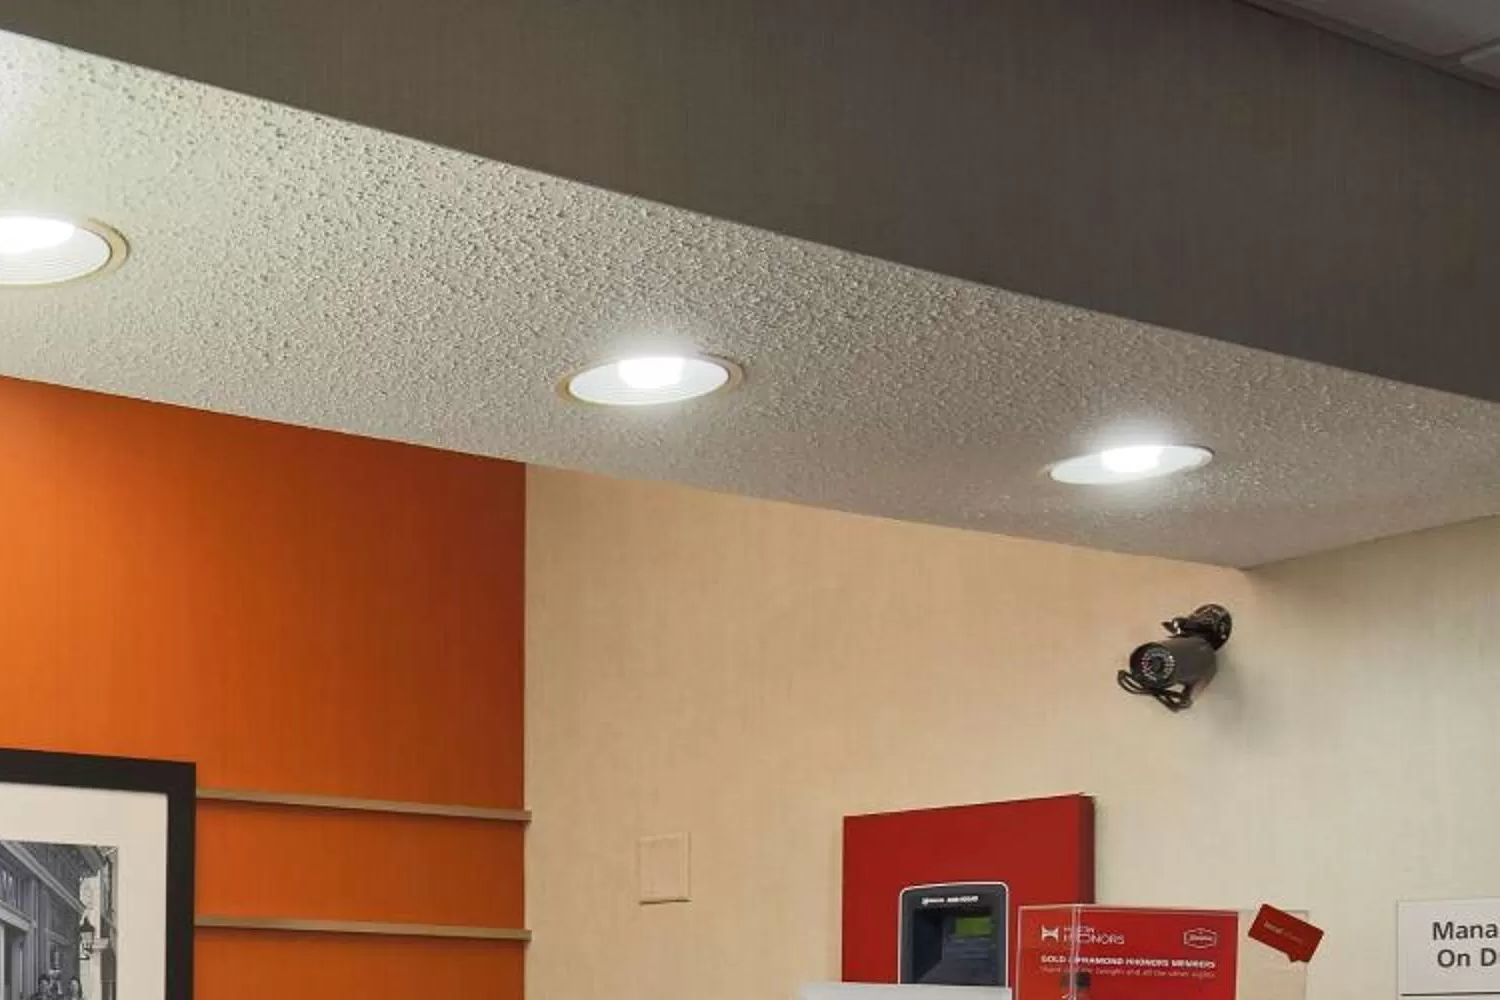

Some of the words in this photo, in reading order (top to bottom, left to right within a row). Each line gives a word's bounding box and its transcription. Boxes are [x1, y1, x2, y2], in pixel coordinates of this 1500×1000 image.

[1432, 921, 1500, 941] Mana
[1437, 948, 1471, 968] On
[1480, 947, 1500, 967] D
